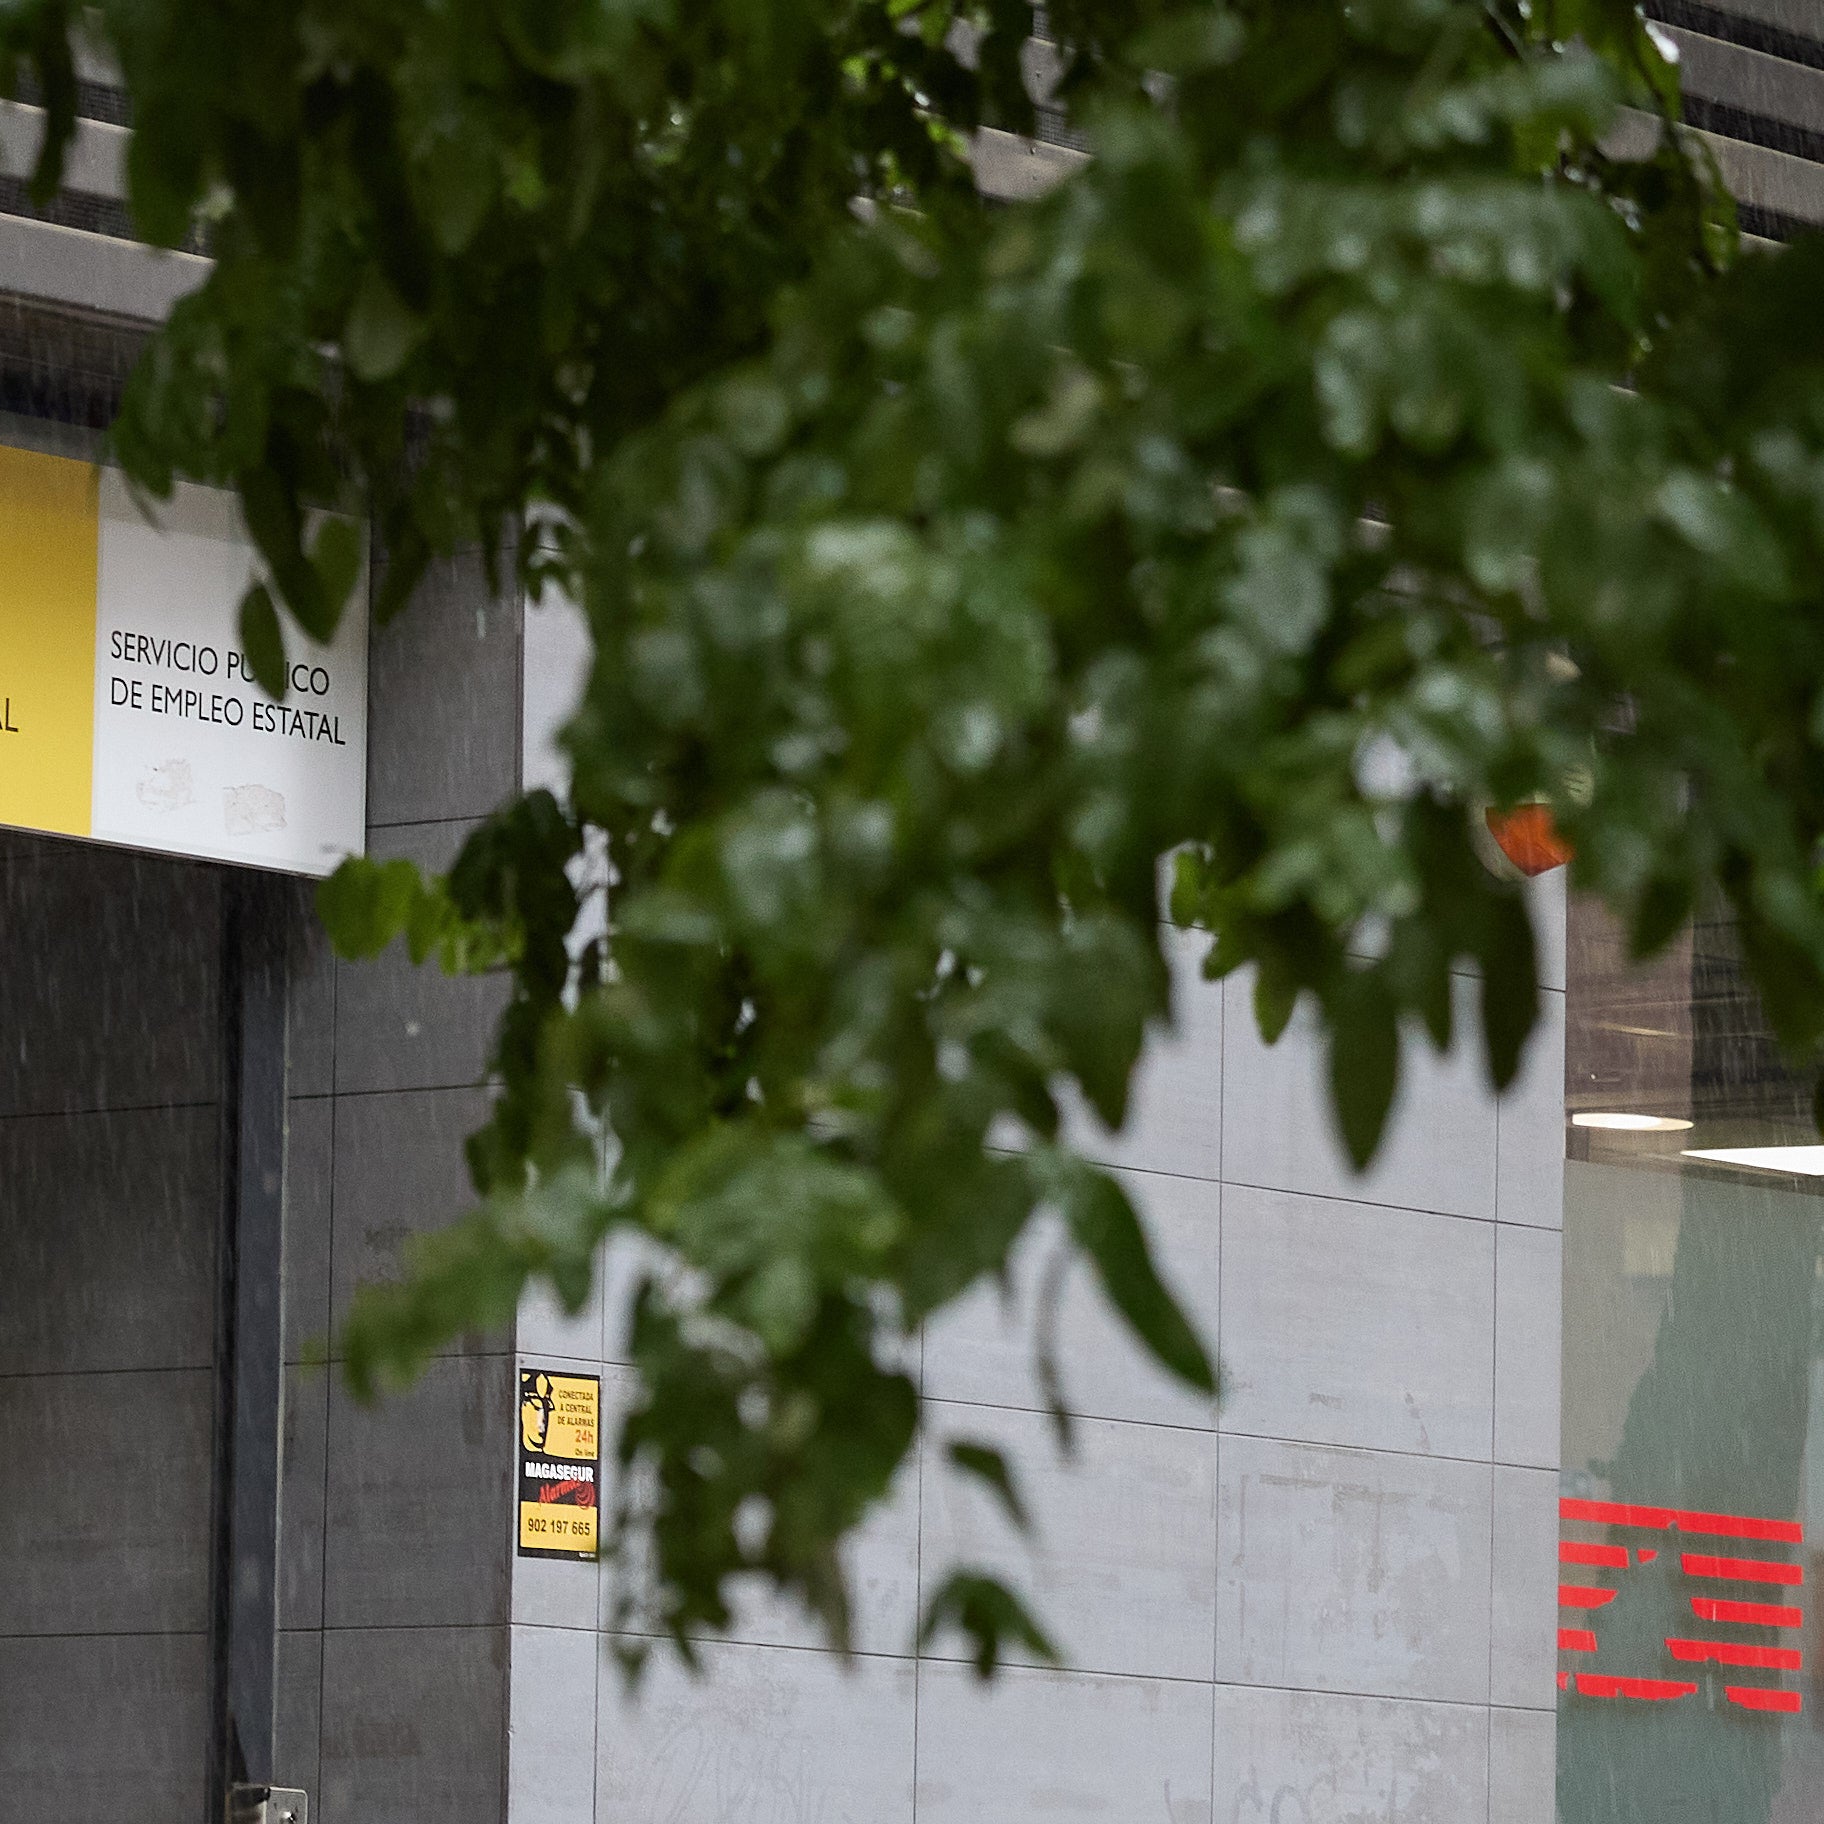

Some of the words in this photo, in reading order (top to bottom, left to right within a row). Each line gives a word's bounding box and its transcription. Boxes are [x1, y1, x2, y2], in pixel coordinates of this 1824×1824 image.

[111, 631, 217, 675] SERVICIO
[228, 652, 329, 695] PICO
[111, 677, 142, 708] DE
[152, 684, 243, 725] EMPLEO
[253, 702, 345, 745] ESTATAL
[558, 1390, 594, 1400] CONECTADA
[566, 1404, 592, 1414] CENTRAL
[558, 1416, 564, 1425] DE
[567, 1417, 594, 1427] ALARMAS
[575, 1430, 594, 1444] 24h
[525, 1462, 594, 1482] MAGASEGUR
[528, 1518, 546, 1532] 902
[552, 1520, 568, 1535] 197
[572, 1522, 590, 1535] 665
